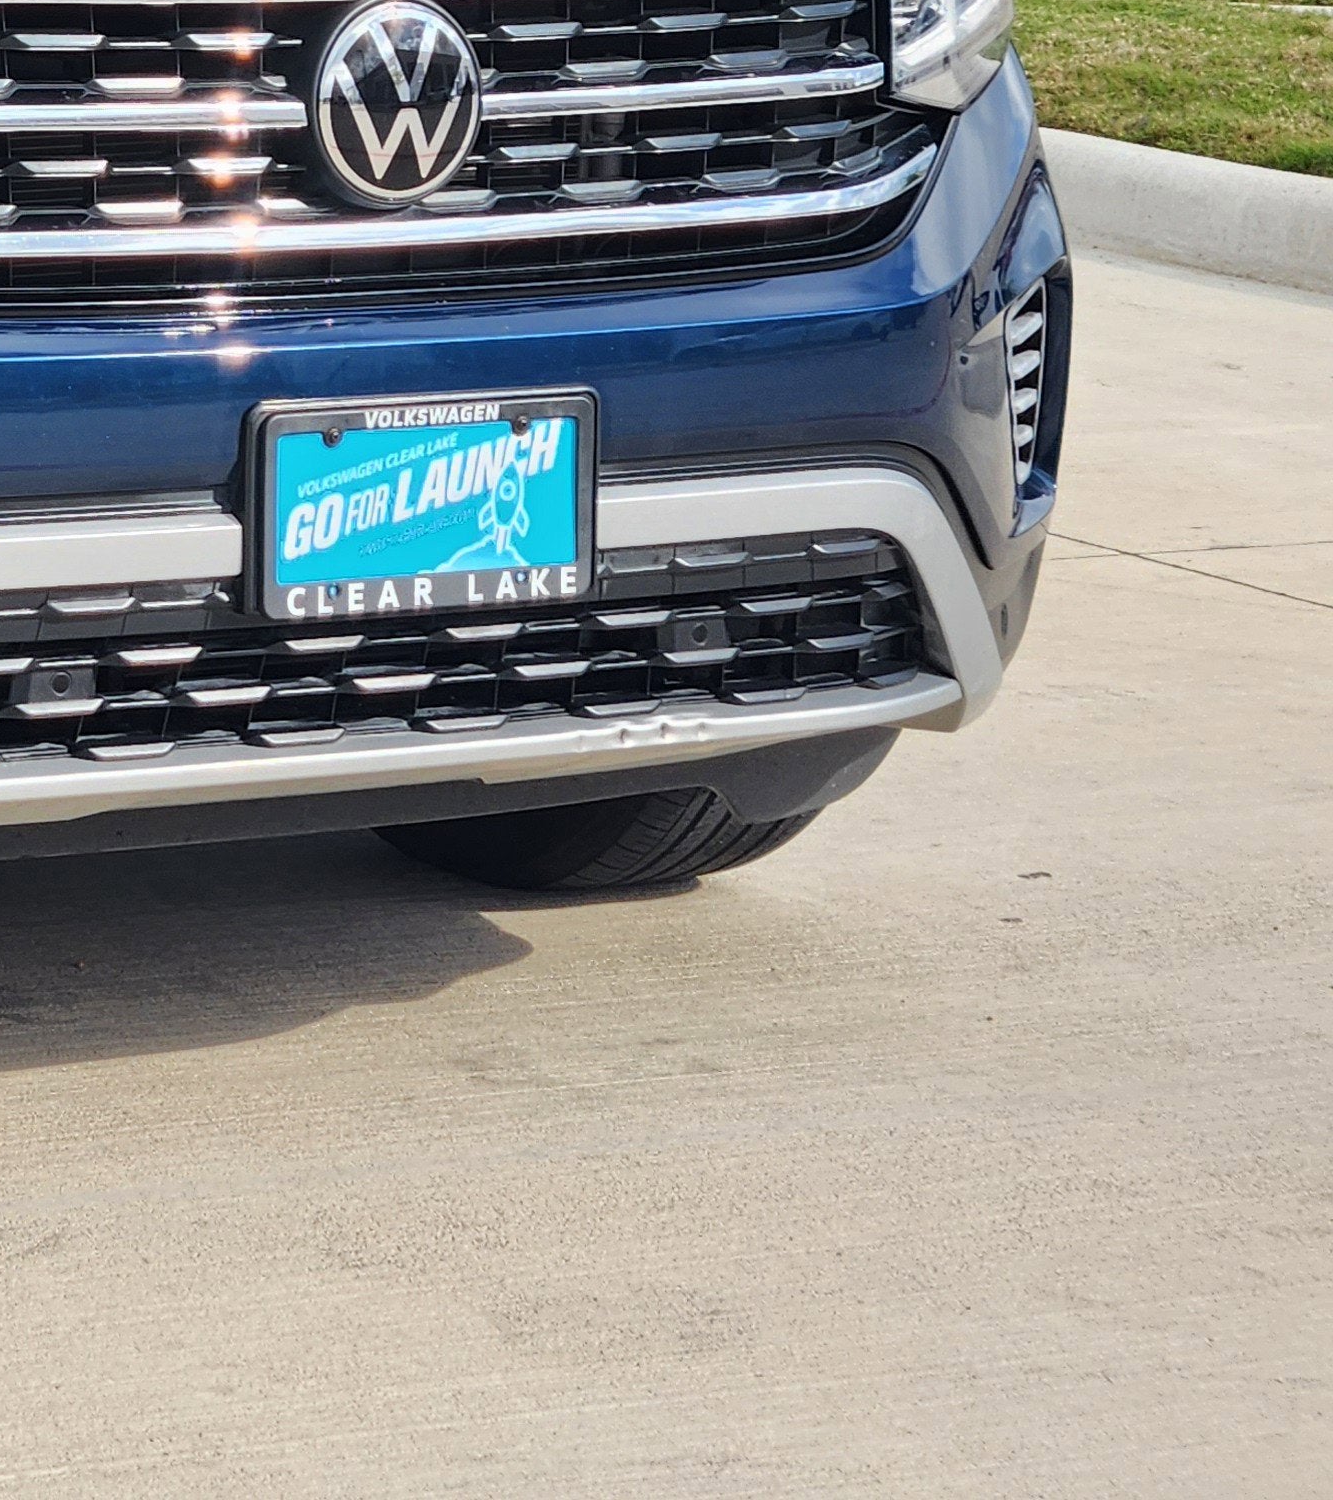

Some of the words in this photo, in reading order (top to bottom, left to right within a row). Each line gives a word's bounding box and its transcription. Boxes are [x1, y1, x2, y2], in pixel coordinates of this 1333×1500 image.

[364, 404, 500, 429] VOLKSWAGEN
[283, 492, 345, 561] GO
[344, 482, 392, 537] FOR
[391, 417, 562, 524] LAUNCH
[297, 457, 383, 499] VOLKSWAGEN
[385, 443, 426, 468] CLEAR
[426, 431, 459, 456] LAKE
[286, 576, 434, 618] CLEAR
[468, 565, 577, 603] LAKE
